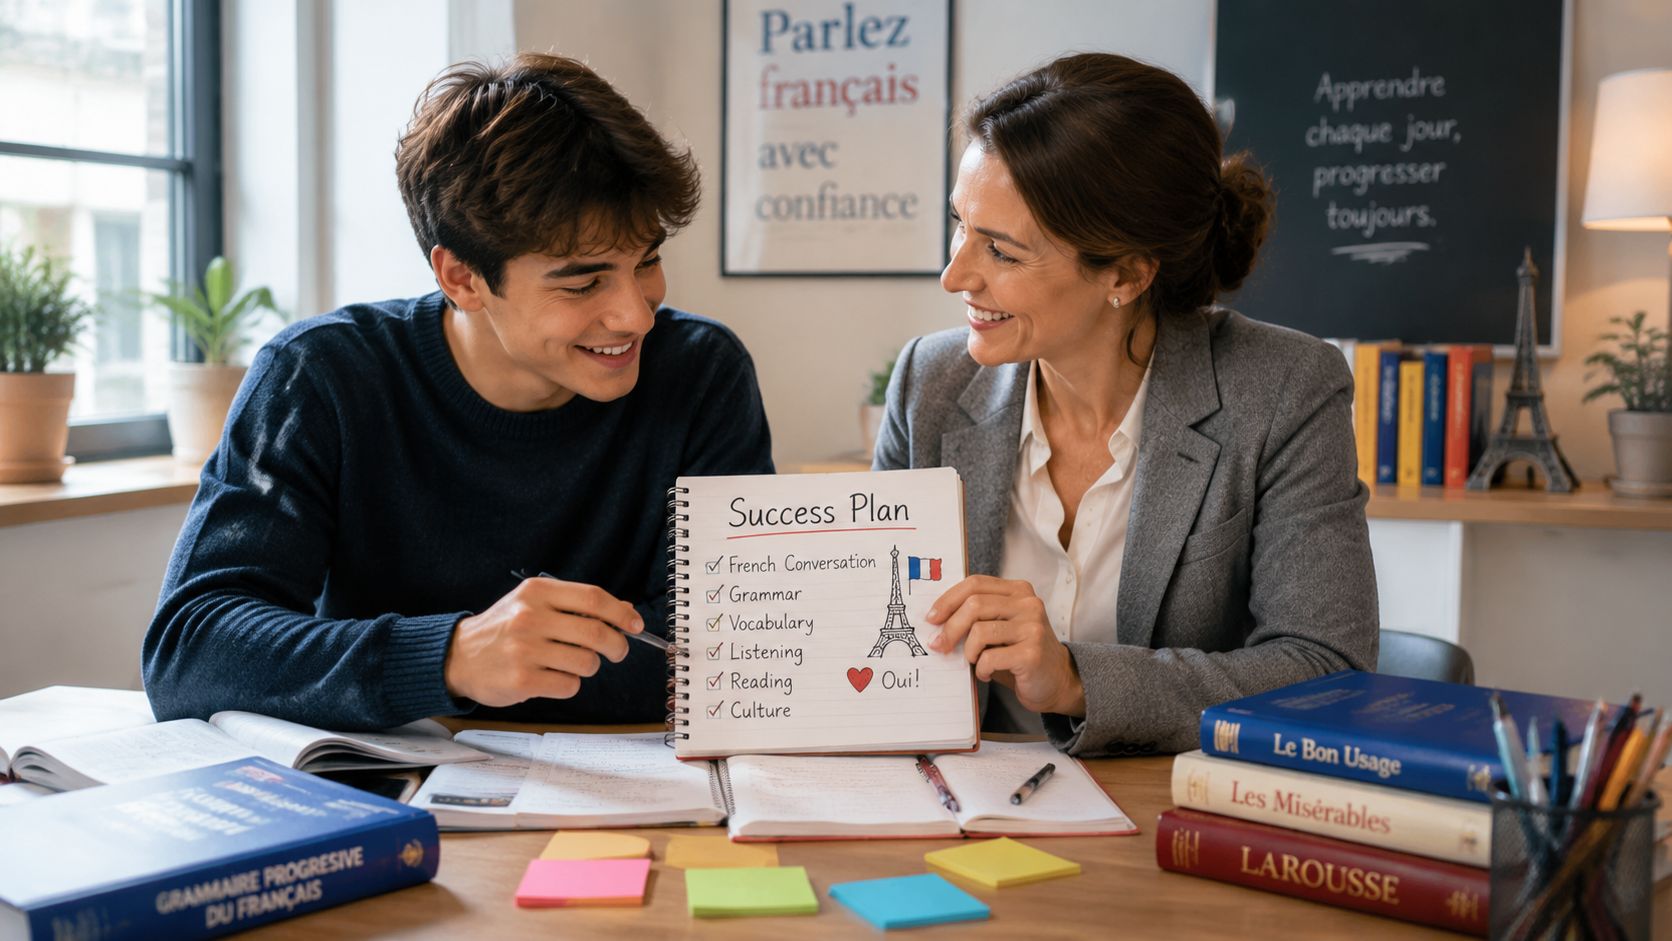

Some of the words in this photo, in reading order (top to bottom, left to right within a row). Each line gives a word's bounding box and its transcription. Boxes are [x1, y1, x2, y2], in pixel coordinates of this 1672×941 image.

[759, 3, 911, 54] Parlez
[759, 64, 919, 117] français
[1313, 66, 1446, 112] Apprendre
[1305, 116, 1392, 152] chaque
[1400, 113, 1461, 152] jour,
[758, 141, 837, 169] avec
[1313, 160, 1446, 197] progresser
[756, 181, 918, 221] confiance
[1326, 201, 1436, 238] toujours.
[728, 497, 835, 528] Success
[850, 492, 909, 523] Plan
[730, 555, 775, 573] French
[785, 554, 876, 572] Conversation
[730, 585, 802, 602] Grammar
[730, 614, 814, 635] Vocabulary
[730, 643, 803, 666] Listening
[731, 672, 793, 695] Reading
[882, 668, 919, 689] Oui!
[730, 701, 791, 719] Culture
[1273, 732, 1297, 756] Le
[1302, 736, 1340, 765] Bon
[1344, 746, 1401, 778] Usage
[1231, 781, 1266, 809] Les
[1273, 790, 1389, 832] Misérables
[156, 871, 260, 913] GRAMMAIRE
[1242, 846, 1399, 904] LAROUSSE
[205, 902, 234, 928] DU
[237, 880, 323, 917] FRANÇAIS
